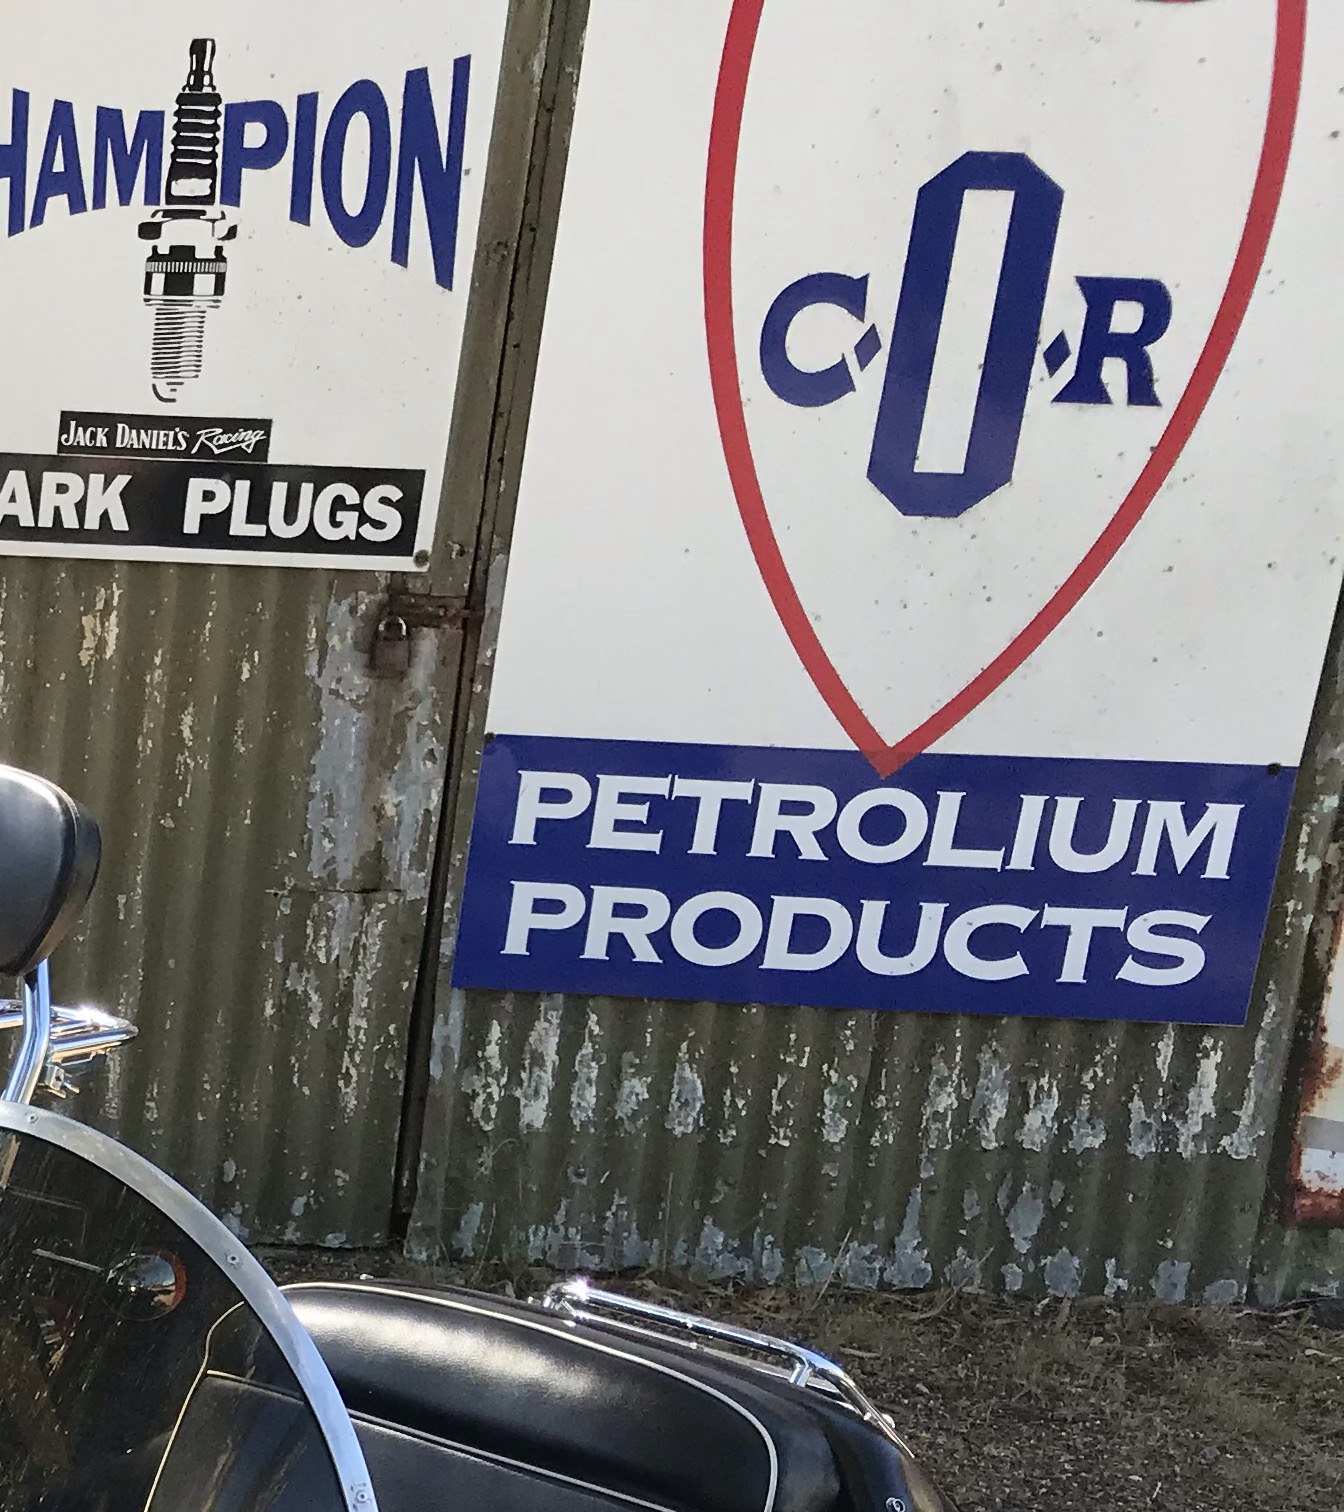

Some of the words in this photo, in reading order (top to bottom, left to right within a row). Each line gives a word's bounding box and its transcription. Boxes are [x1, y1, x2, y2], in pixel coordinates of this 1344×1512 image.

[60, 420, 110, 448] JACK
[115, 422, 190, 452] DANIEL'S
[190, 427, 267, 455] Racing
[182, 476, 405, 543] PLUGS
[506, 769, 1246, 881] PETROLIUM
[499, 880, 1214, 988] PRODUCTS
